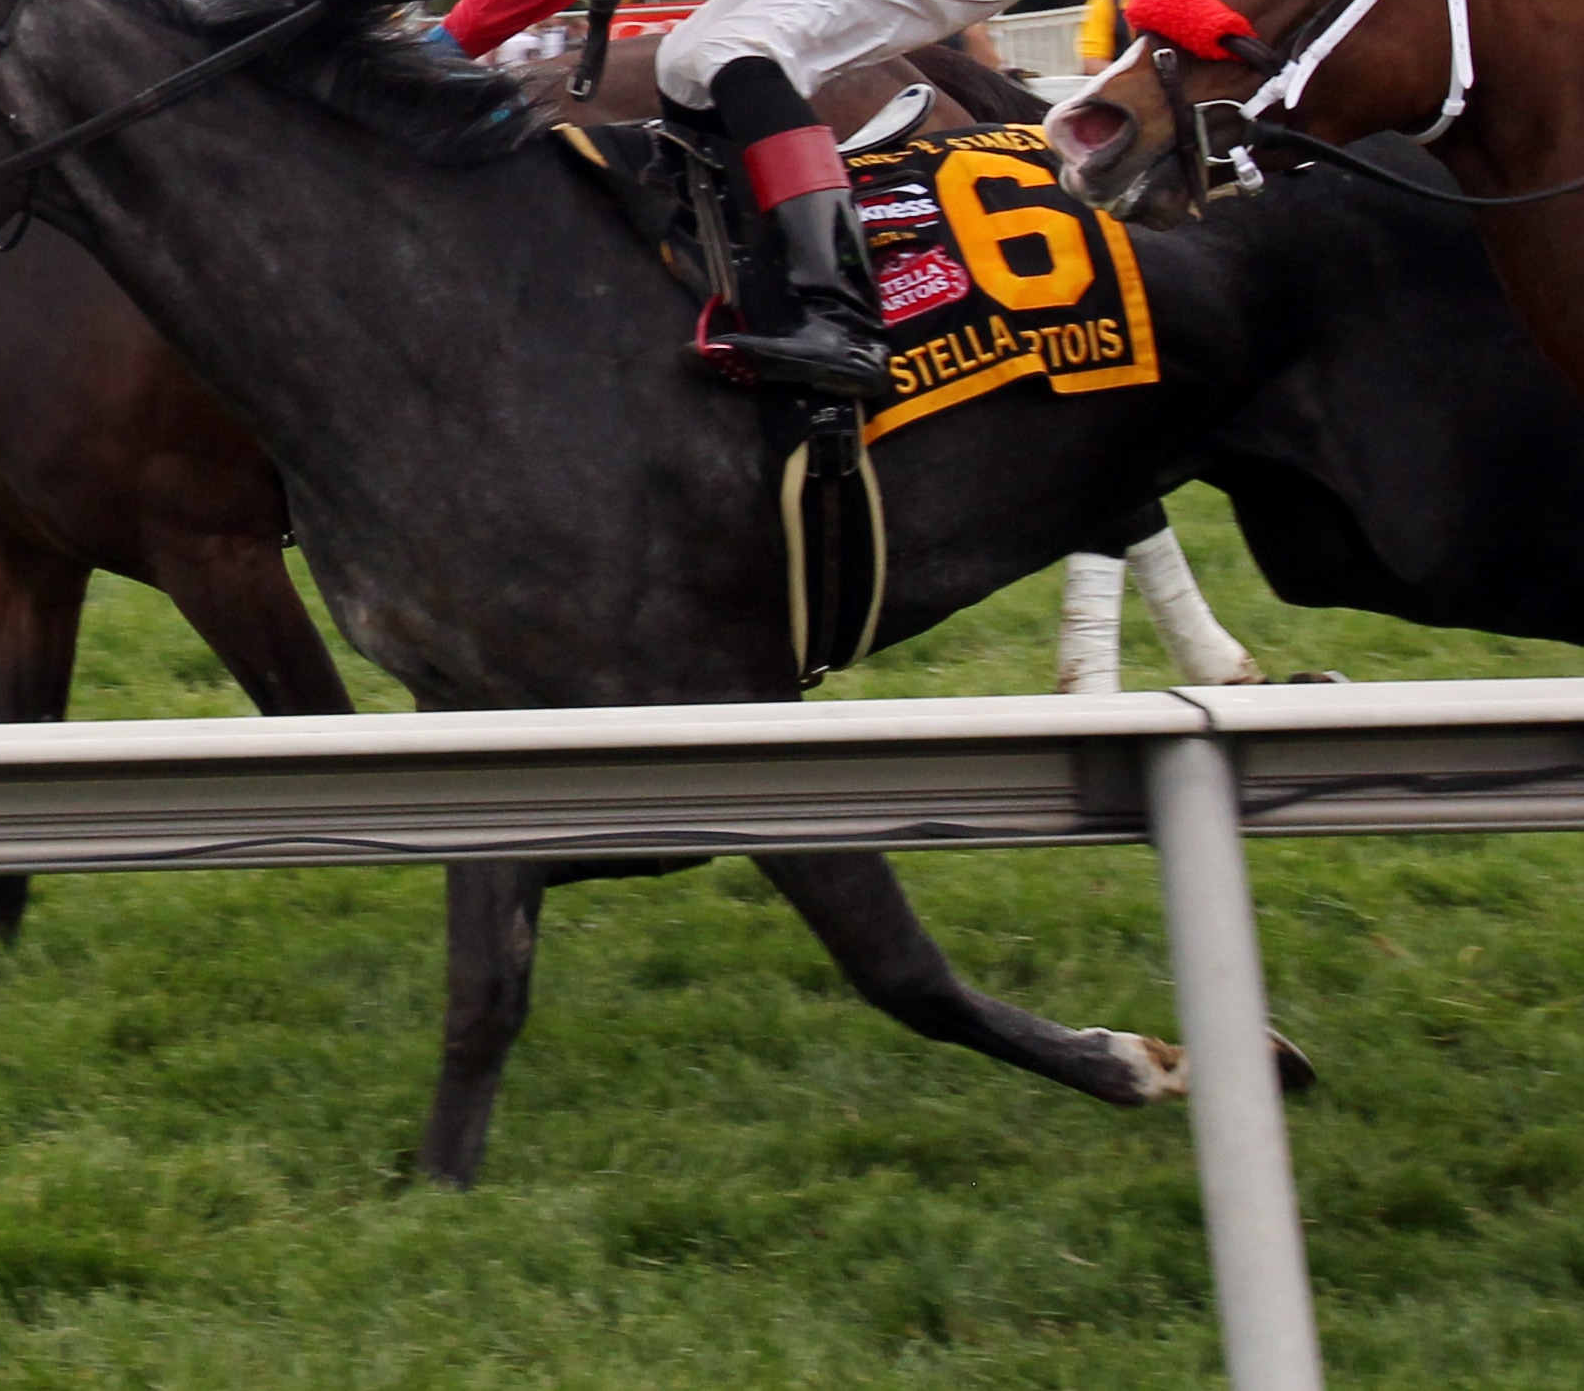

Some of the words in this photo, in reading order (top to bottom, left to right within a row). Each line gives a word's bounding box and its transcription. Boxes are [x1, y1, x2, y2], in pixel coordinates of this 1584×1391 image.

[854, 198, 941, 223] kness
[934, 149, 1096, 311] 6
[878, 263, 949, 296] TELLA
[889, 314, 1020, 394] STELLA
[1018, 318, 1124, 368] TOIS
